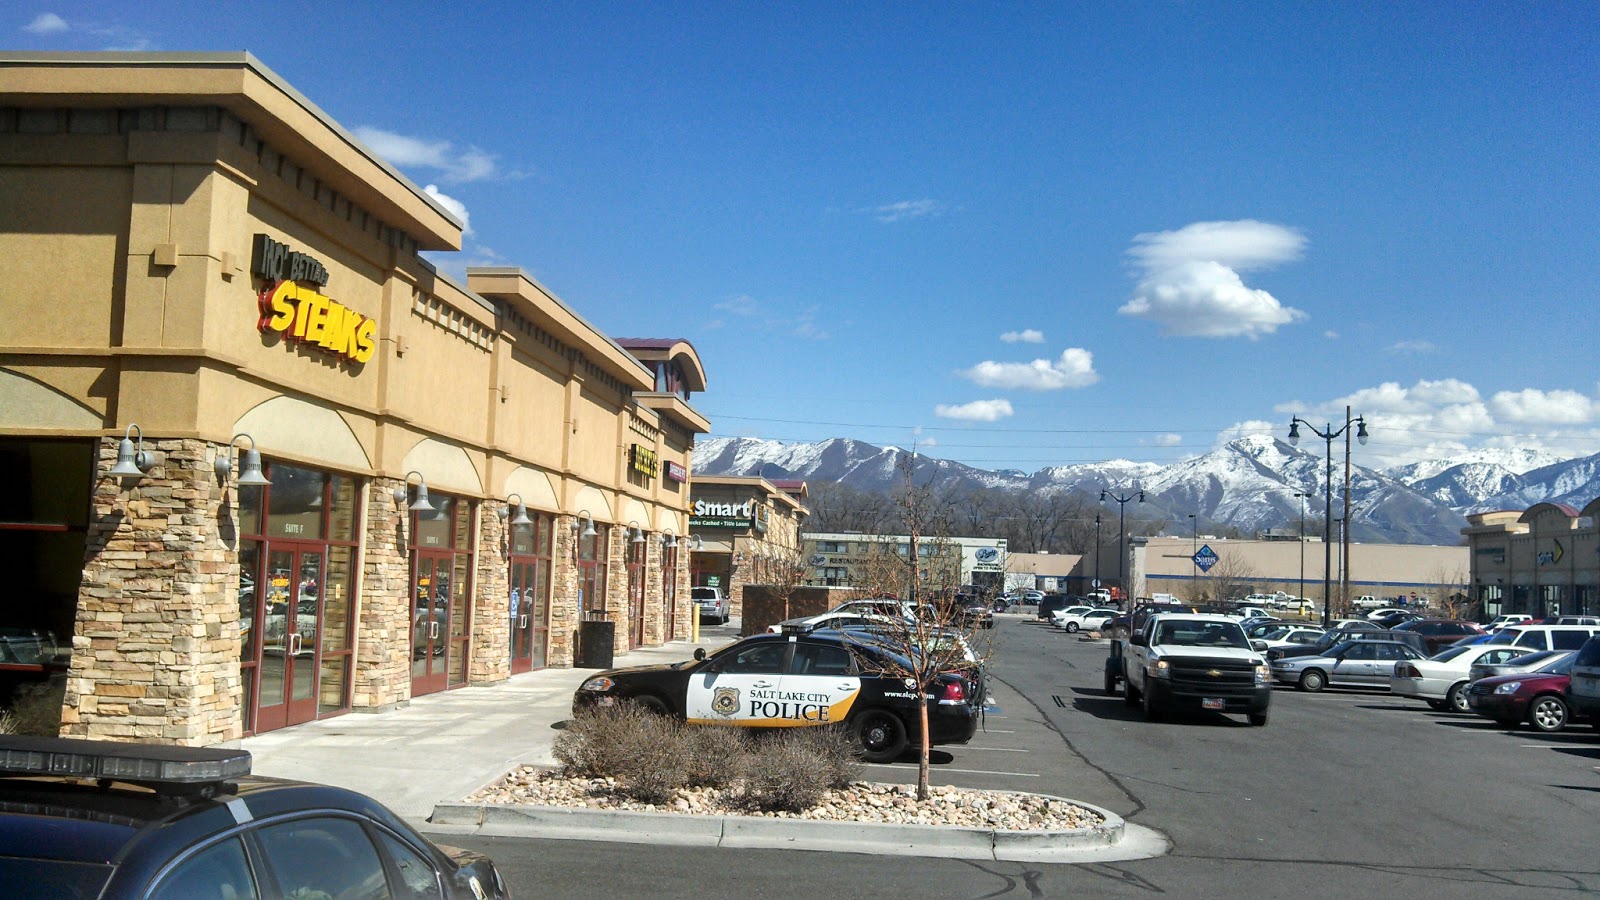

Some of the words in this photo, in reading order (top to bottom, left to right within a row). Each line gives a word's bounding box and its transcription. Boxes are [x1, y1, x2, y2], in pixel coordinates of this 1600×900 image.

[270, 280, 376, 363] STEAKS
[285, 523, 299, 533] SUITE
[750, 690, 776, 699] SALT
[778, 691, 806, 701] LAKE
[807, 693, 832, 703] CITY
[749, 700, 830, 722] POLICE
